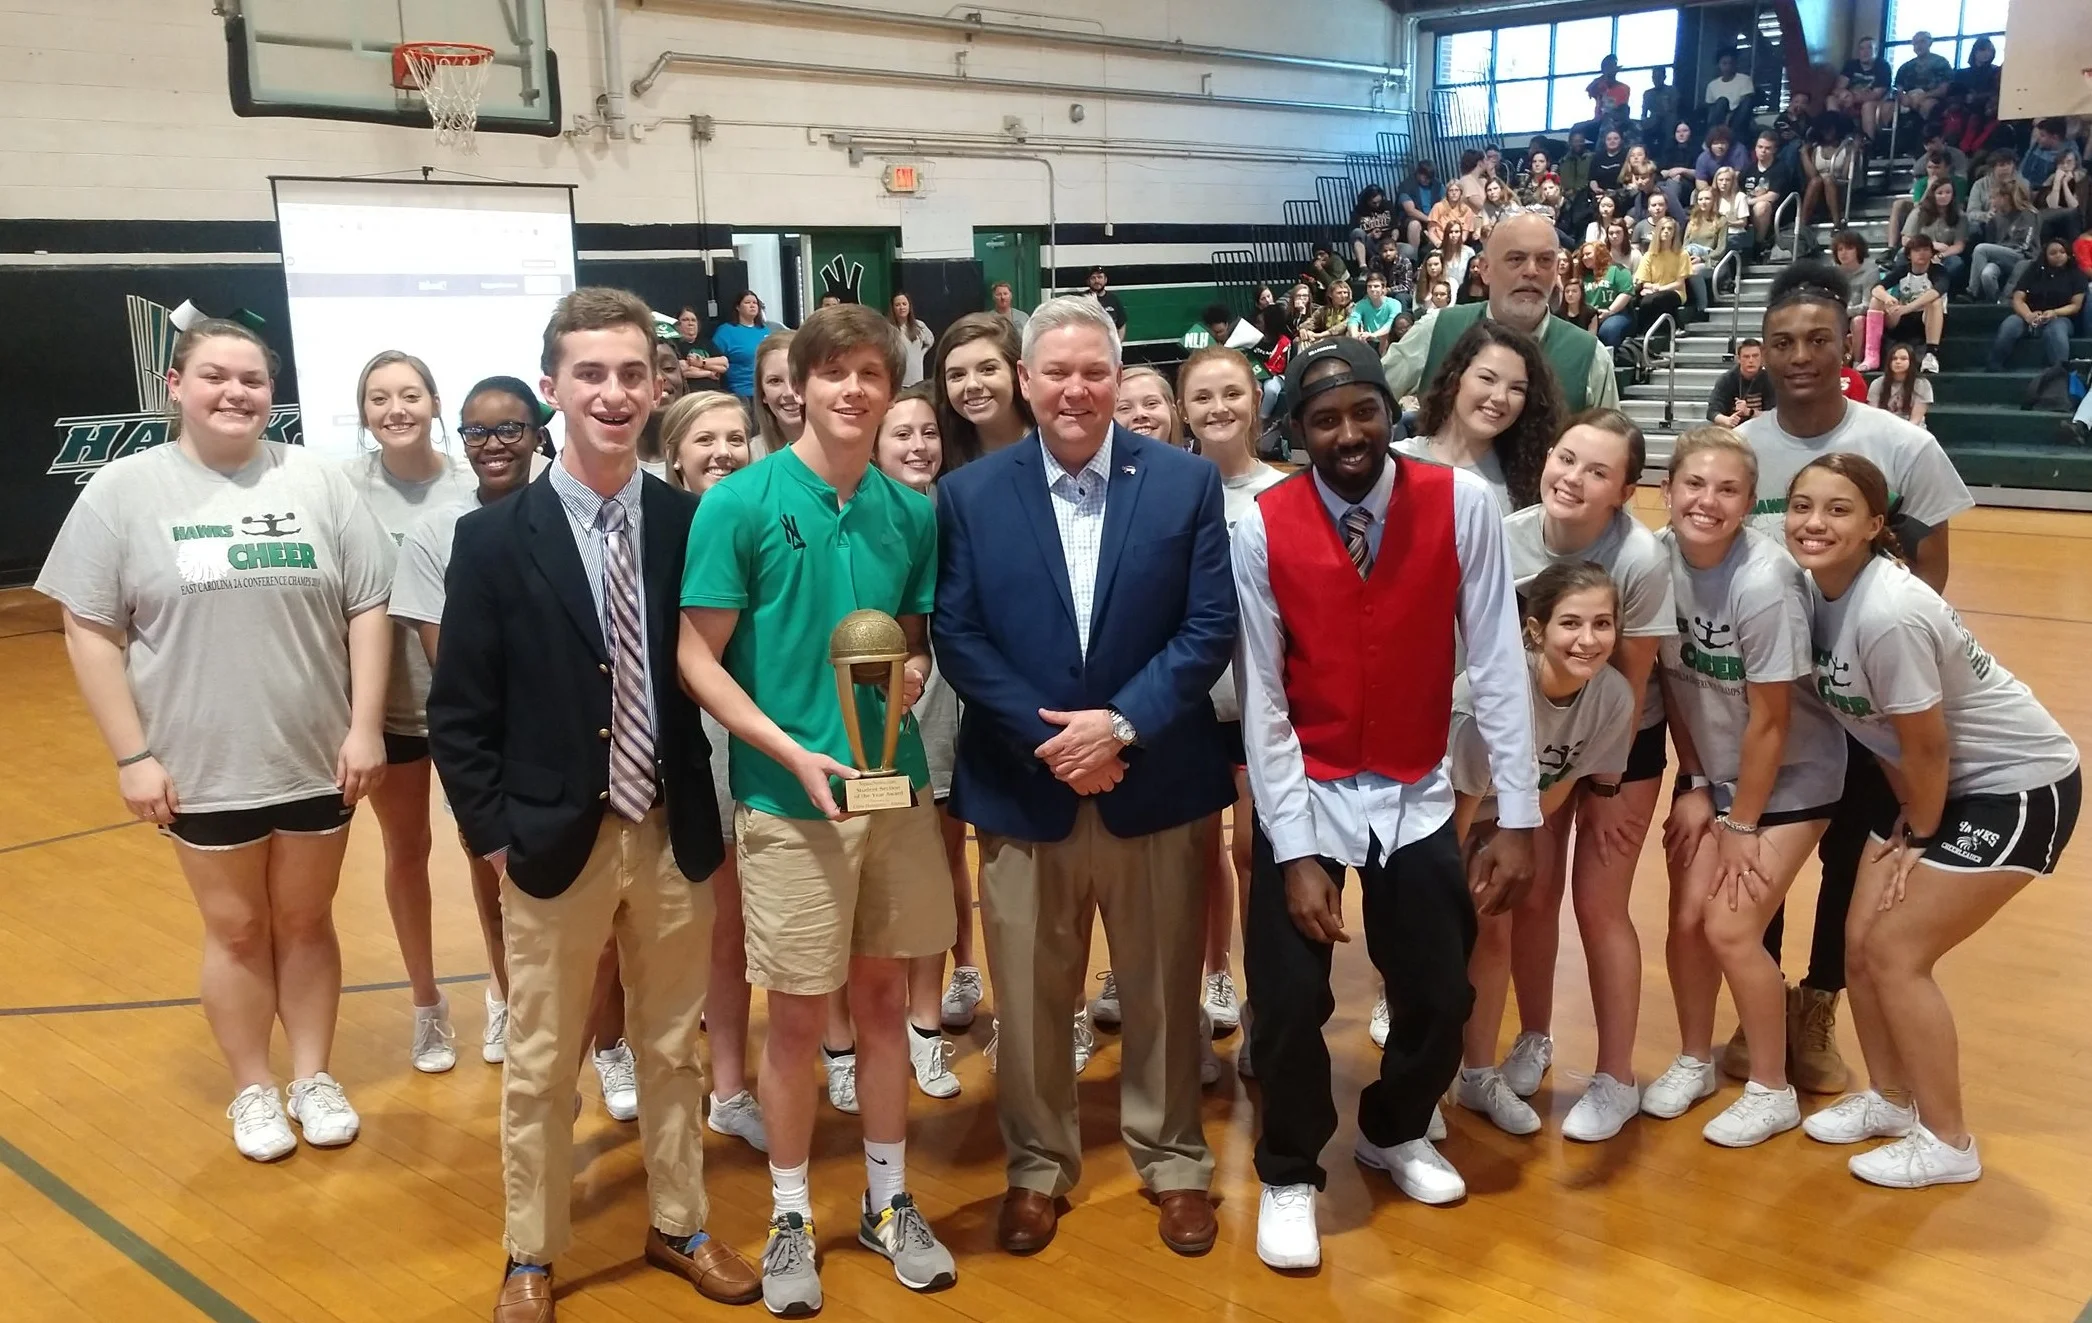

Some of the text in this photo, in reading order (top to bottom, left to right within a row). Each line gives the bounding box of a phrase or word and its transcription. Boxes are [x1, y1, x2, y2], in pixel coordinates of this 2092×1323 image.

[1602, 290, 1614, 302] 17
[1184, 332, 1210, 349] NLH
[172, 524, 234, 541] HAWKS
[227, 542, 318, 570] CHEER
[180, 583, 197, 595] EAST
[199, 578, 233, 593] CAROLINA
[233, 577, 244, 589] 2A
[243, 575, 287, 588] CONFERENCE
[288, 575, 311, 586] CHAMPS
